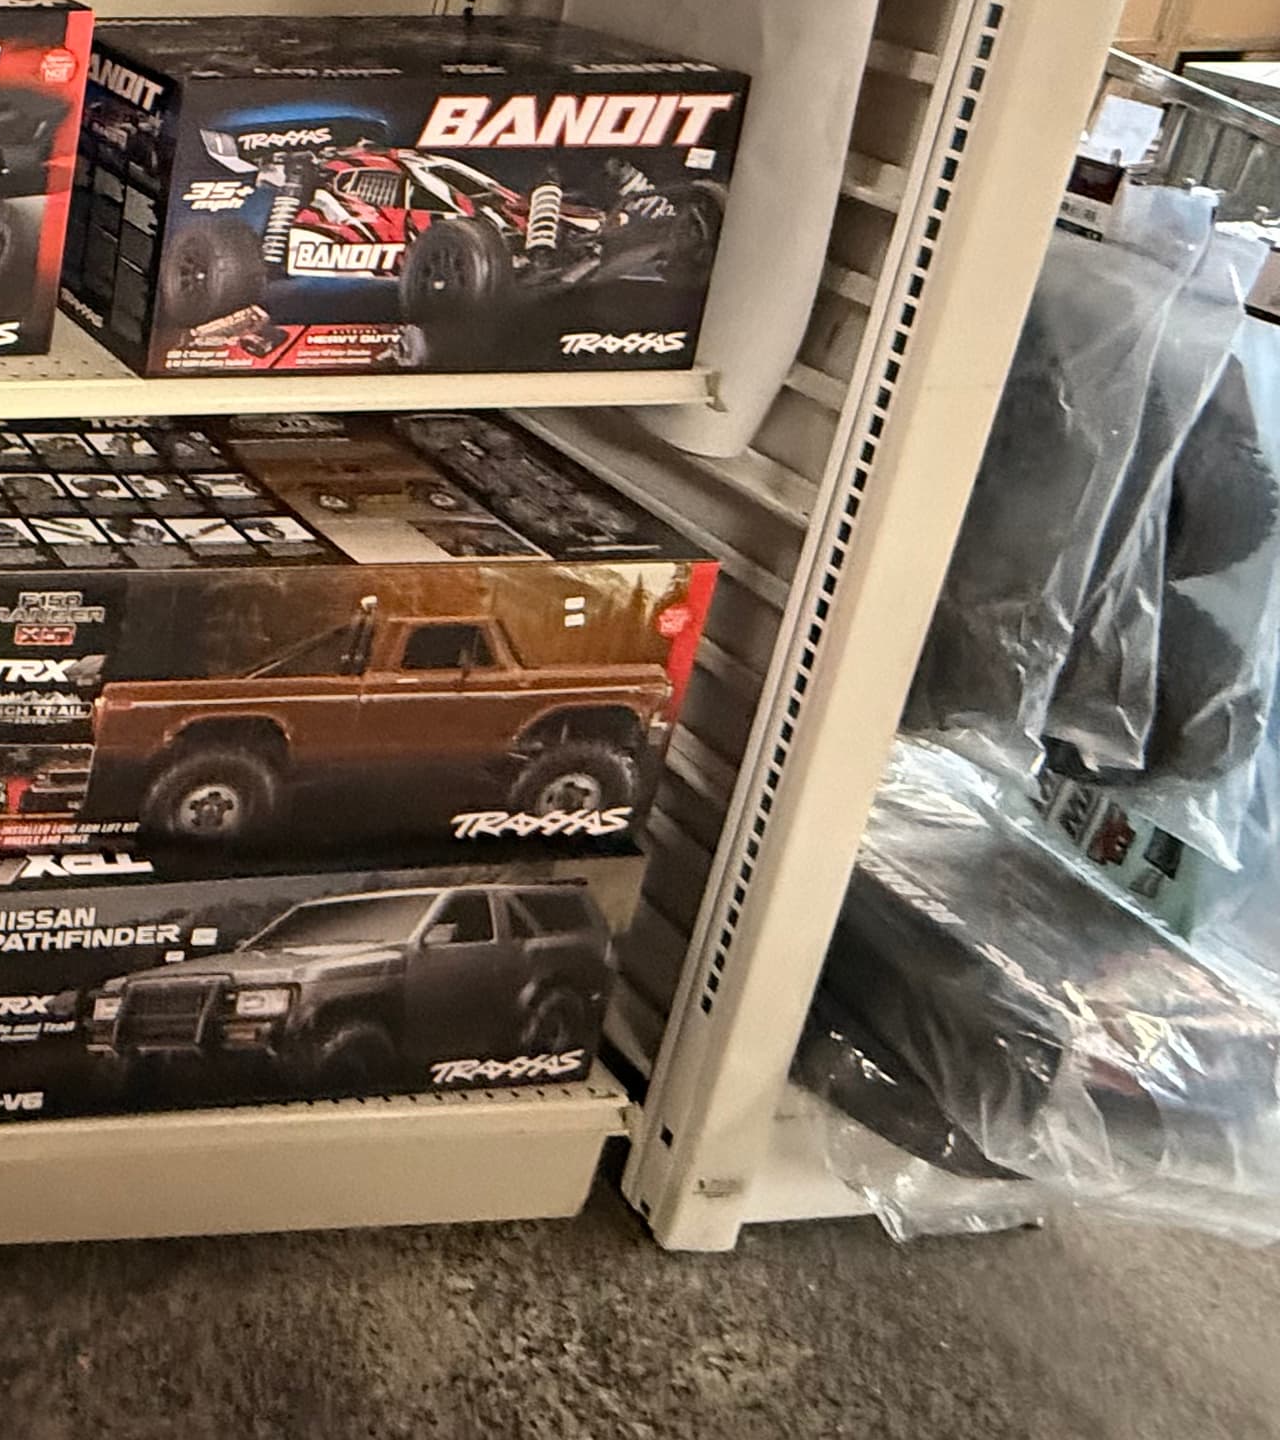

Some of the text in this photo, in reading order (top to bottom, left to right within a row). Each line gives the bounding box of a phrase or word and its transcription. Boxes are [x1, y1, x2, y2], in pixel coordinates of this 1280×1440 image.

[417, 93, 735, 150] BANDIT
[238, 127, 332, 150] TRAXXAS
[183, 181, 255, 202] 35+
[192, 196, 244, 212] mph
[295, 241, 405, 271] BANDIT
[306, 334, 402, 345] HEAVY DUTY
[560, 331, 687, 356] TRAXXAS
[33, 703, 88, 717] TRAIL
[450, 806, 635, 840] TRAXXAS
[432, 1047, 587, 1085] TRAXXAS
